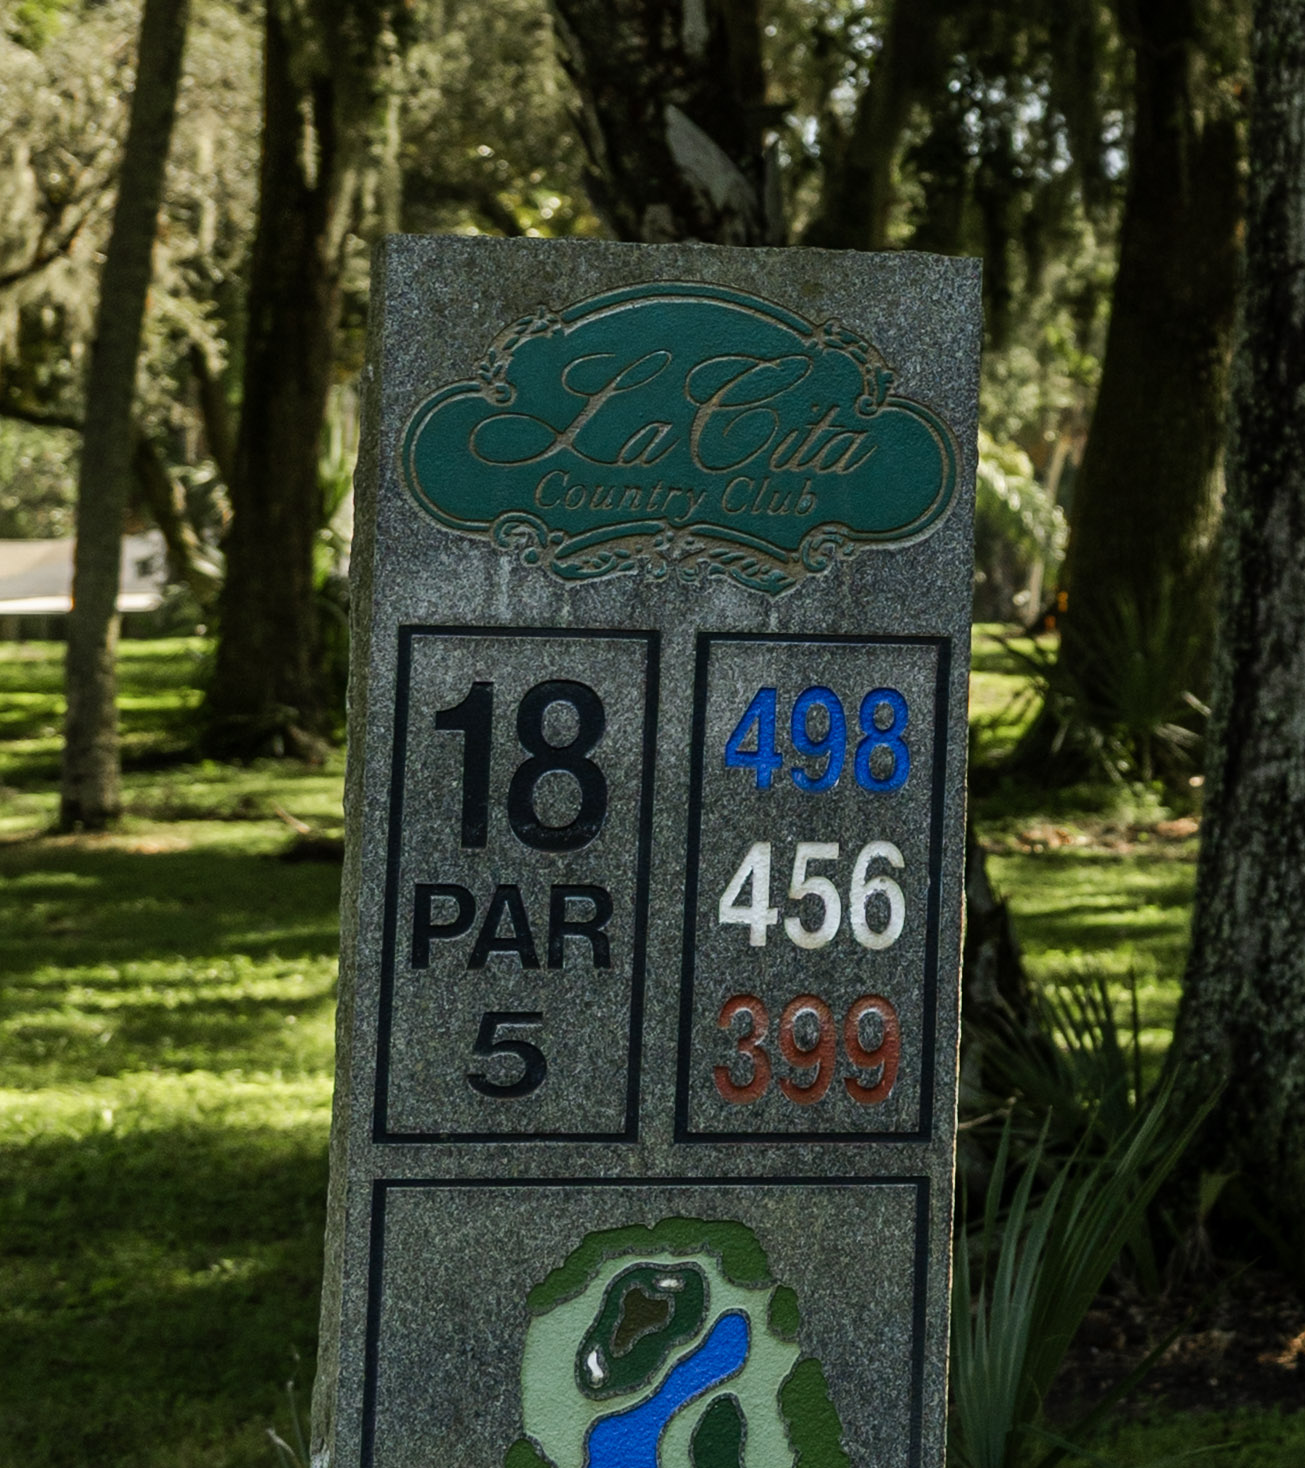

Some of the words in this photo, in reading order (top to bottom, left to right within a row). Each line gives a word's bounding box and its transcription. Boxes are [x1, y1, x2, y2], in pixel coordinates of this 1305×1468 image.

[469, 350, 683, 468] La
[683, 355, 878, 478] Cita
[534, 469, 708, 525] Country
[720, 478, 818, 517] Club
[435, 680, 608, 853] 18
[724, 687, 911, 795] 498
[411, 883, 615, 970] PAR
[717, 840, 906, 950] 456
[466, 1011, 547, 1099] 5
[714, 994, 901, 1105] 399
